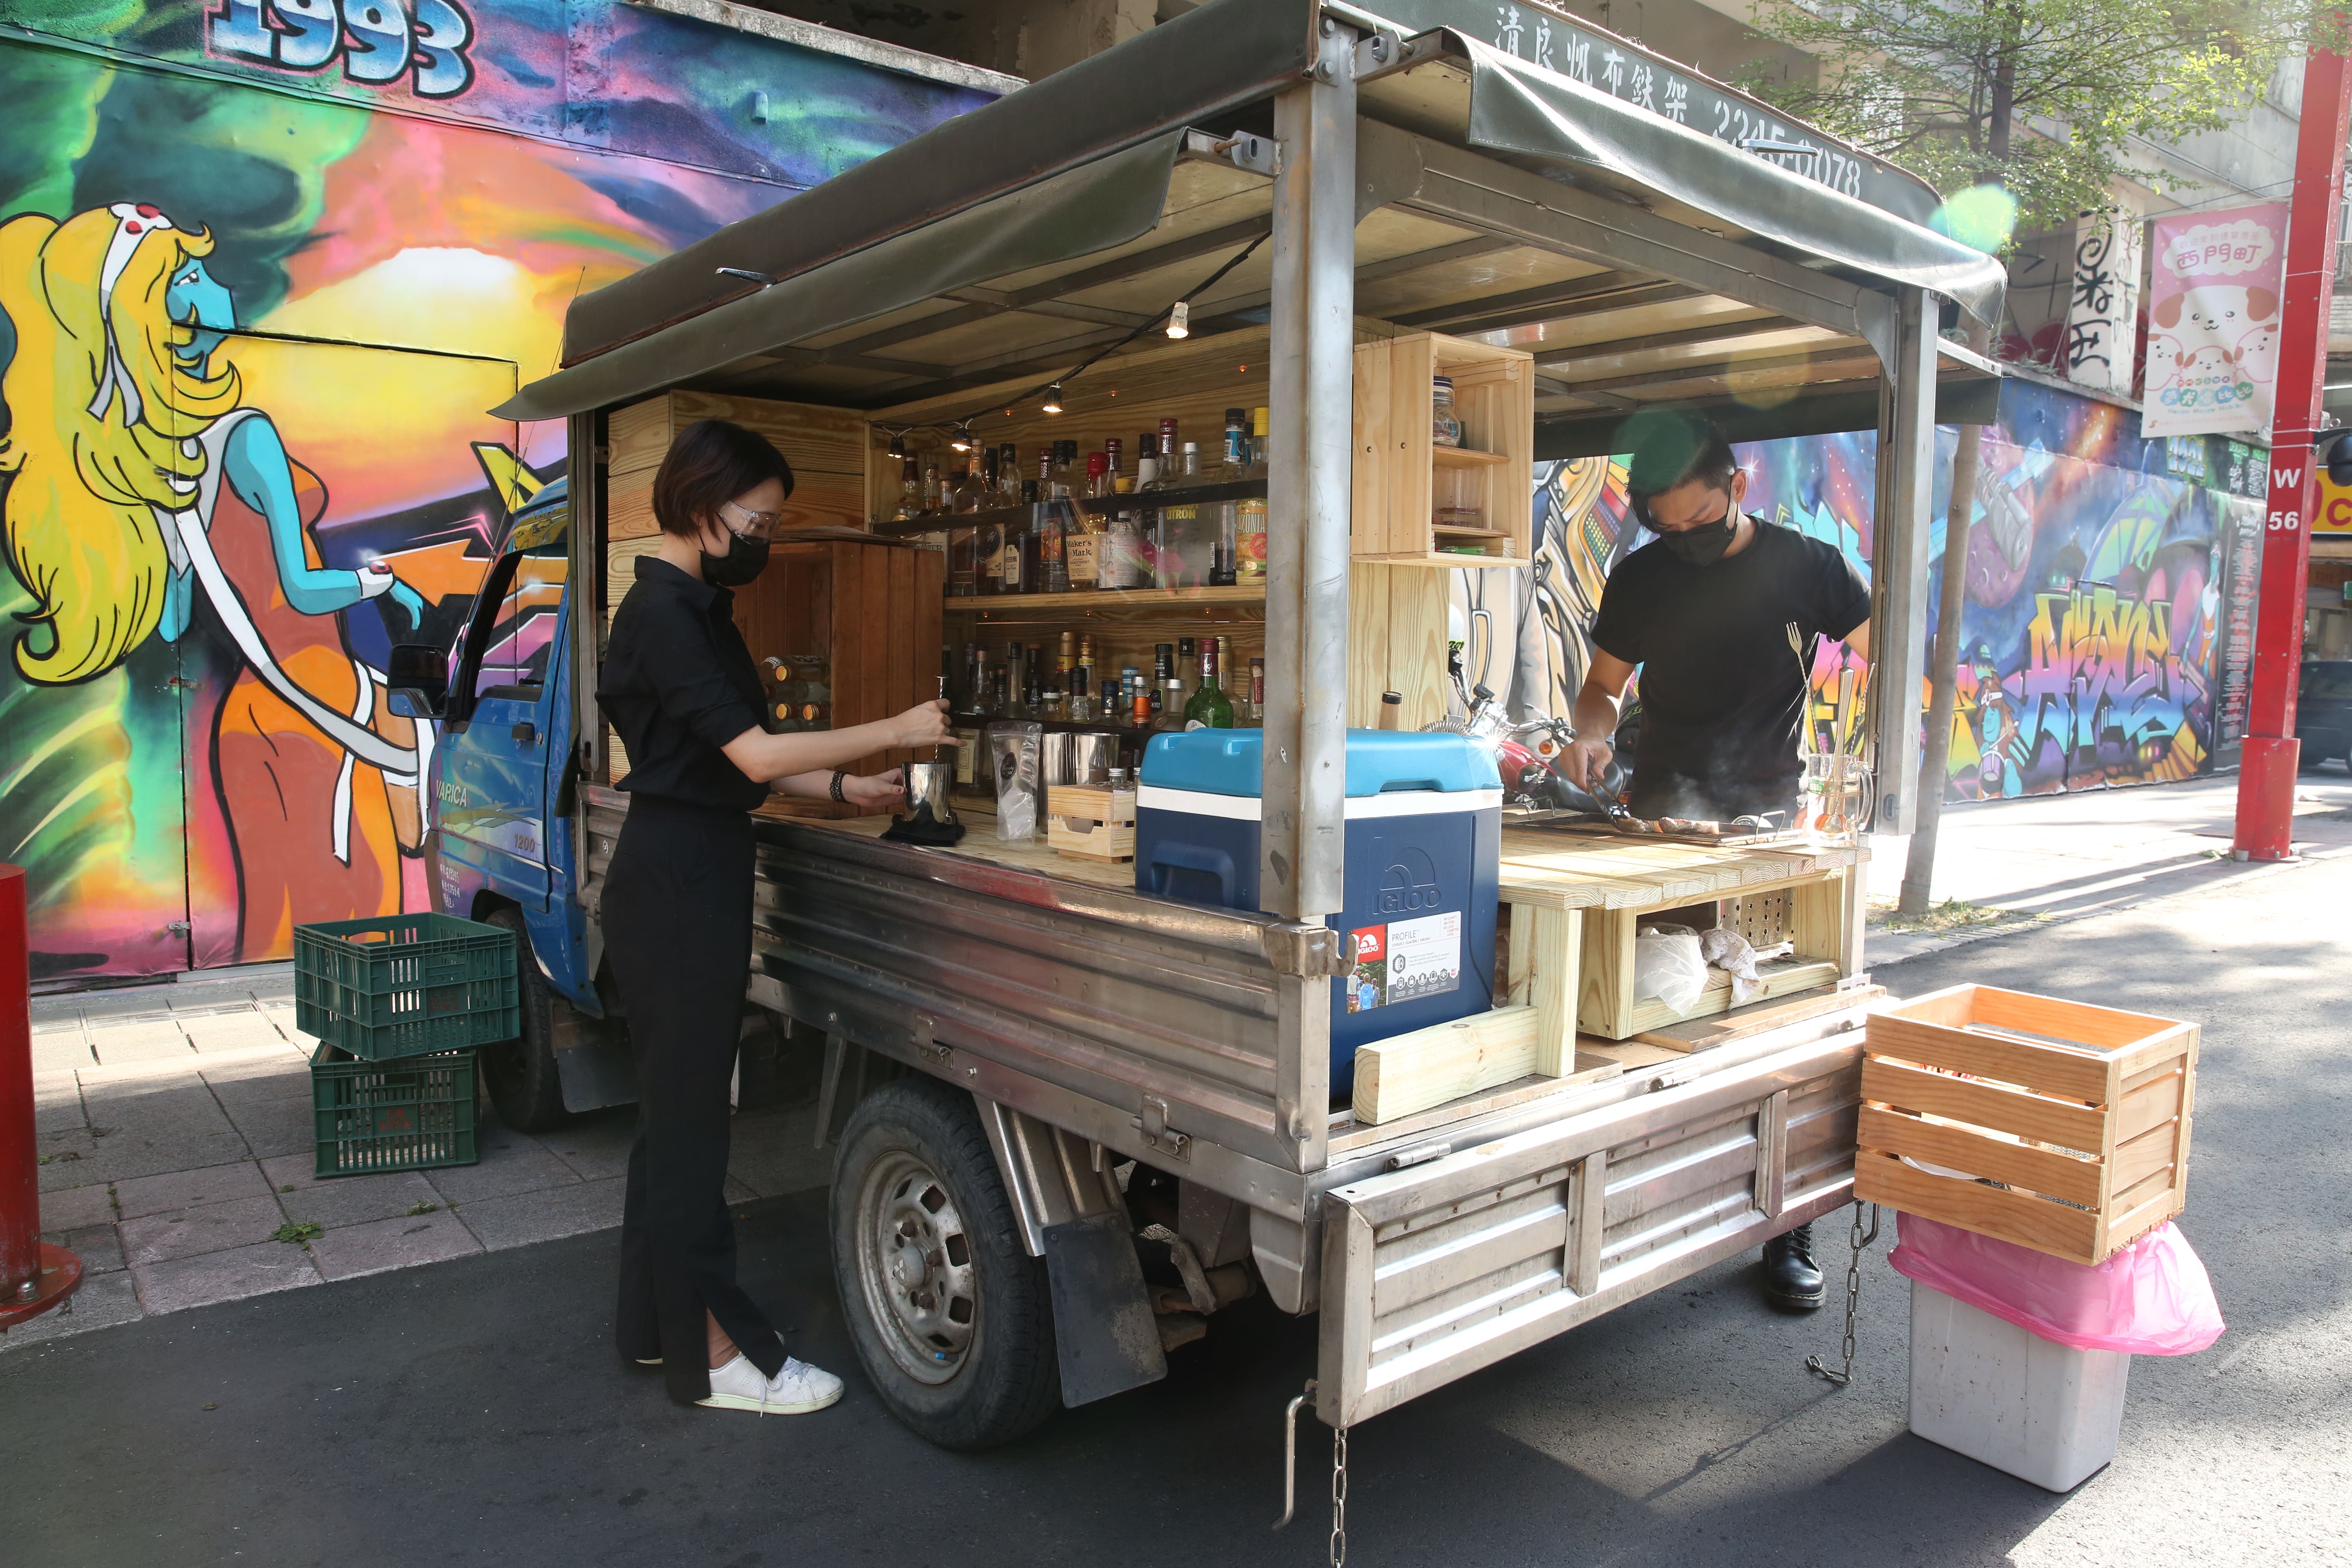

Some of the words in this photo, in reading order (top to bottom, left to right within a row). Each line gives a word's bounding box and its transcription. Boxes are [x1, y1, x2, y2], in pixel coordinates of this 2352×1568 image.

[210, 0, 474, 98] 1993
[2177, 243, 2262, 270] 西門町
[2168, 436, 2205, 478] 2021
[2274, 468, 2301, 488] W
[1167, 509, 1196, 519] CITRON
[2268, 511, 2299, 530] 56
[436, 780, 467, 807] VARICA
[514, 833, 535, 853] 1200
[1372, 888, 1441, 915] IGLOO
[1392, 930, 1416, 942] PROFILE
[1358, 945, 1379, 954] IGLOO
